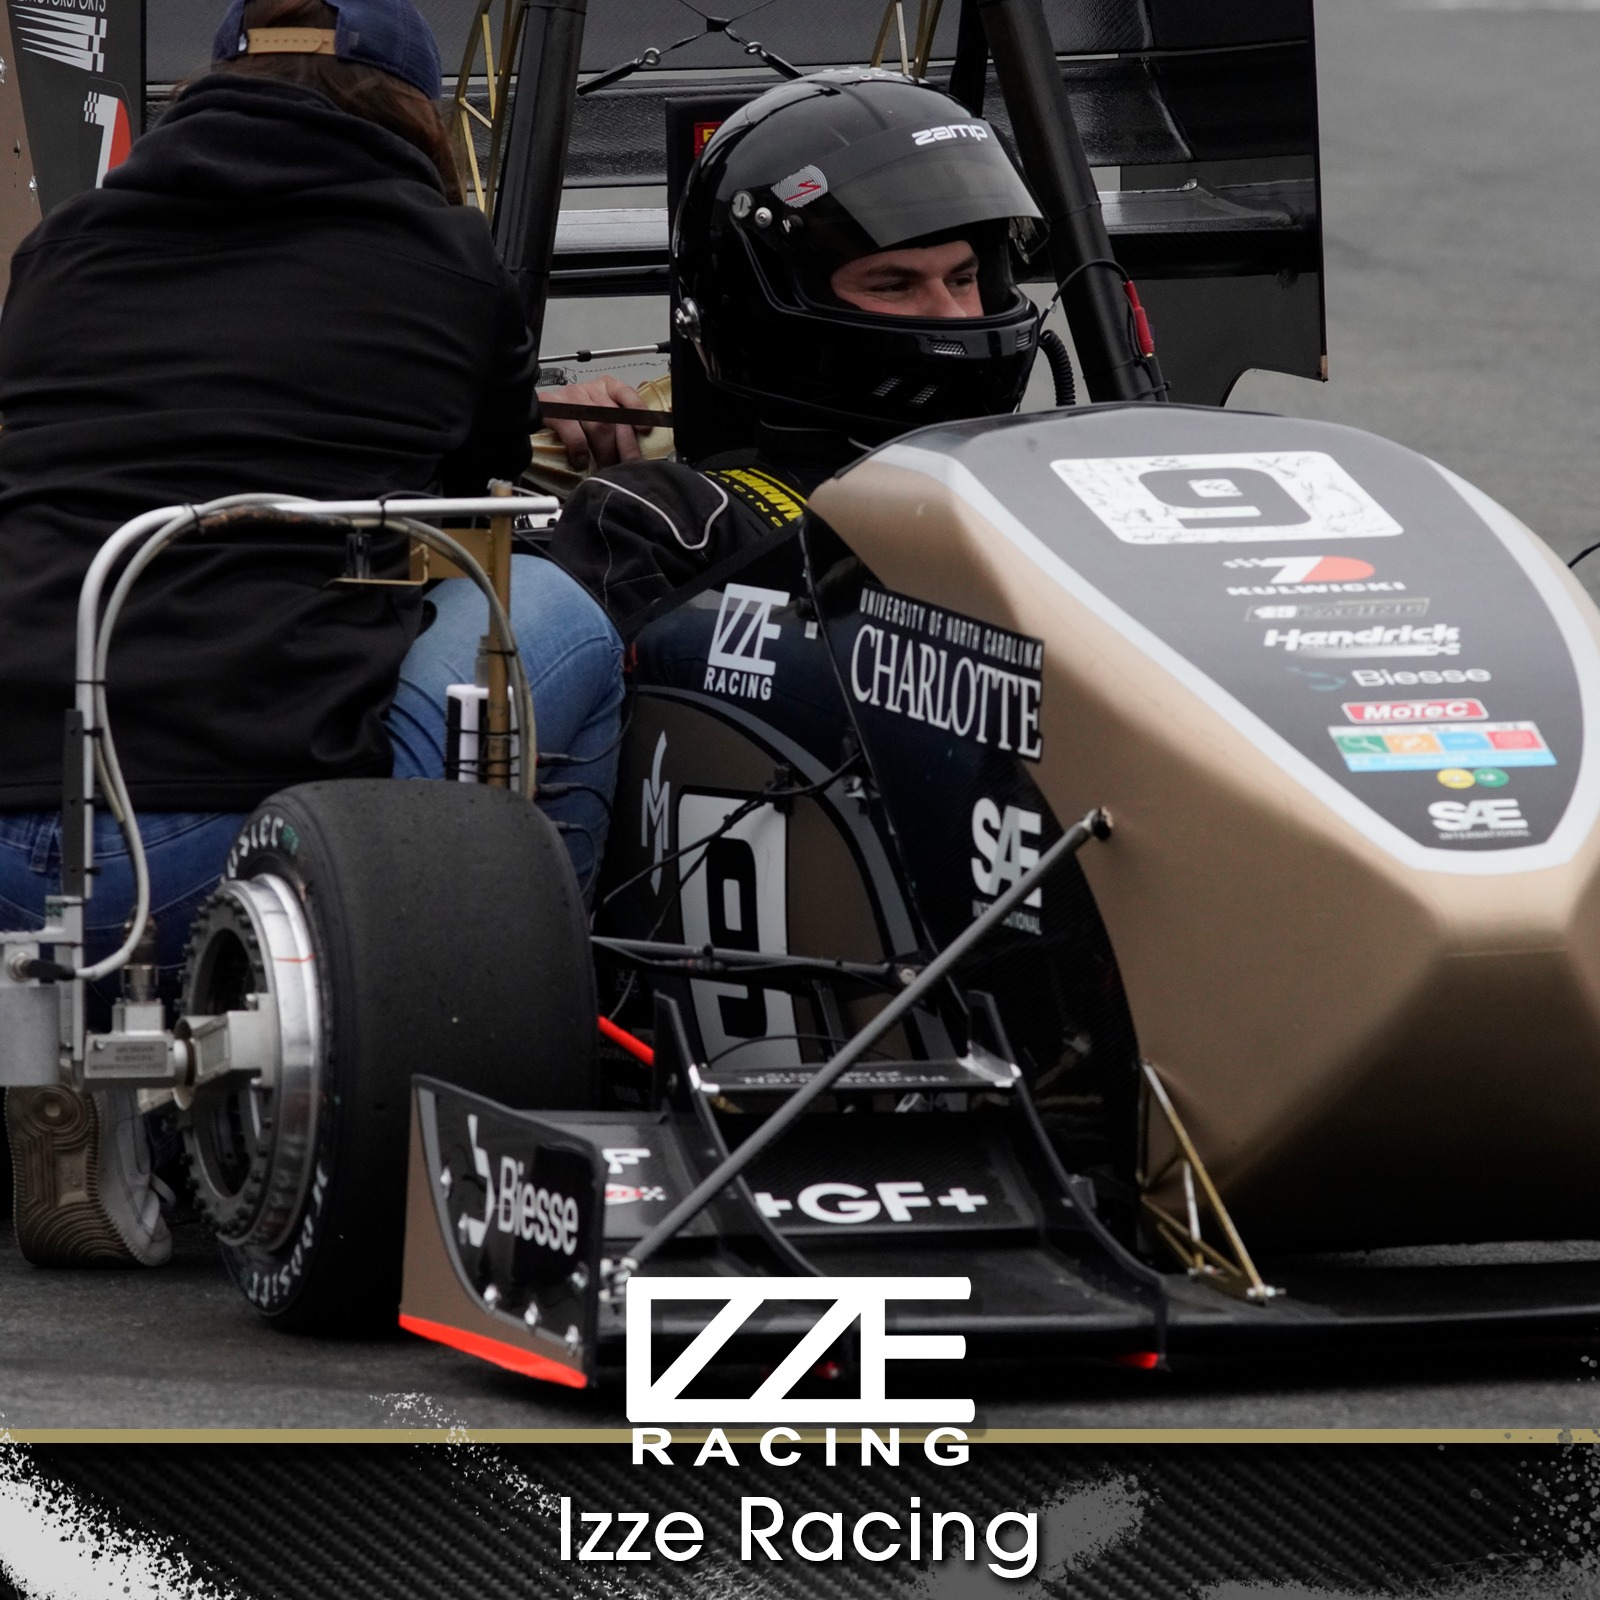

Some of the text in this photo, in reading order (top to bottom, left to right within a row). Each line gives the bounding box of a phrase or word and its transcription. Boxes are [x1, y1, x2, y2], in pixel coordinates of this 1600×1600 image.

[912, 124, 988, 146] zamp
[1226, 581, 1407, 596] KULWICKI
[859, 587, 1044, 671] UNIVERSITY OF NORTH CAROLINA
[1263, 624, 1461, 651] Hendrick
[703, 666, 773, 701] RACING
[850, 623, 1042, 760] CHARLOTTE
[1351, 668, 1492, 687] Biesse
[1364, 701, 1470, 721] MoTeC
[1427, 798, 1529, 832] SAE
[497, 1155, 579, 1256] Biesse
